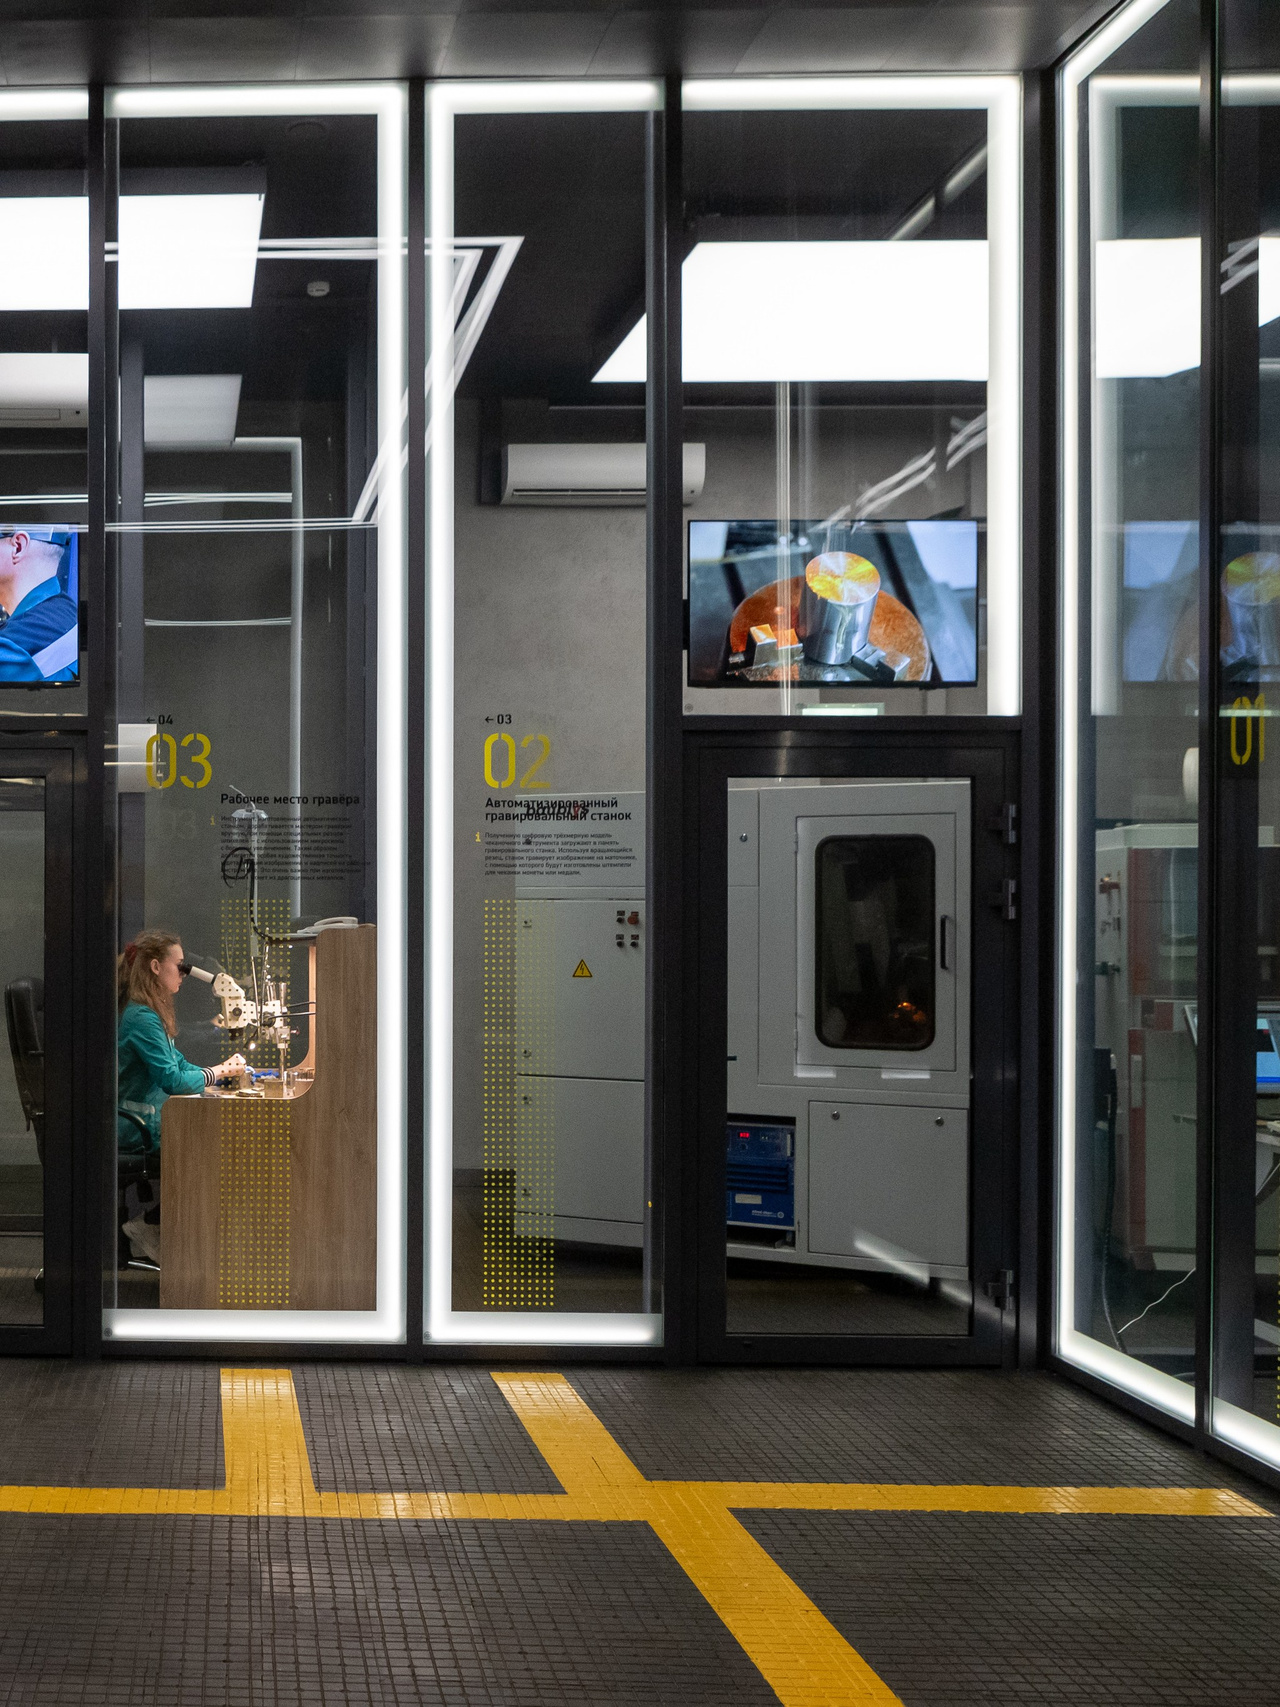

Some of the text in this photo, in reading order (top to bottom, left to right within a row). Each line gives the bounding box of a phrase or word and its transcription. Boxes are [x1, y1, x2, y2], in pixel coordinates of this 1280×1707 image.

[158, 715, 173, 724] 04
[497, 714, 512, 724] 03
[1230, 693, 1265, 765] 01
[146, 734, 212, 788] 03
[484, 732, 550, 788] 02
[221, 794, 360, 805] Рабочее место гравёра
[485, 798, 618, 808] Автоматизированный
[485, 810, 632, 822] гравировальный станок
